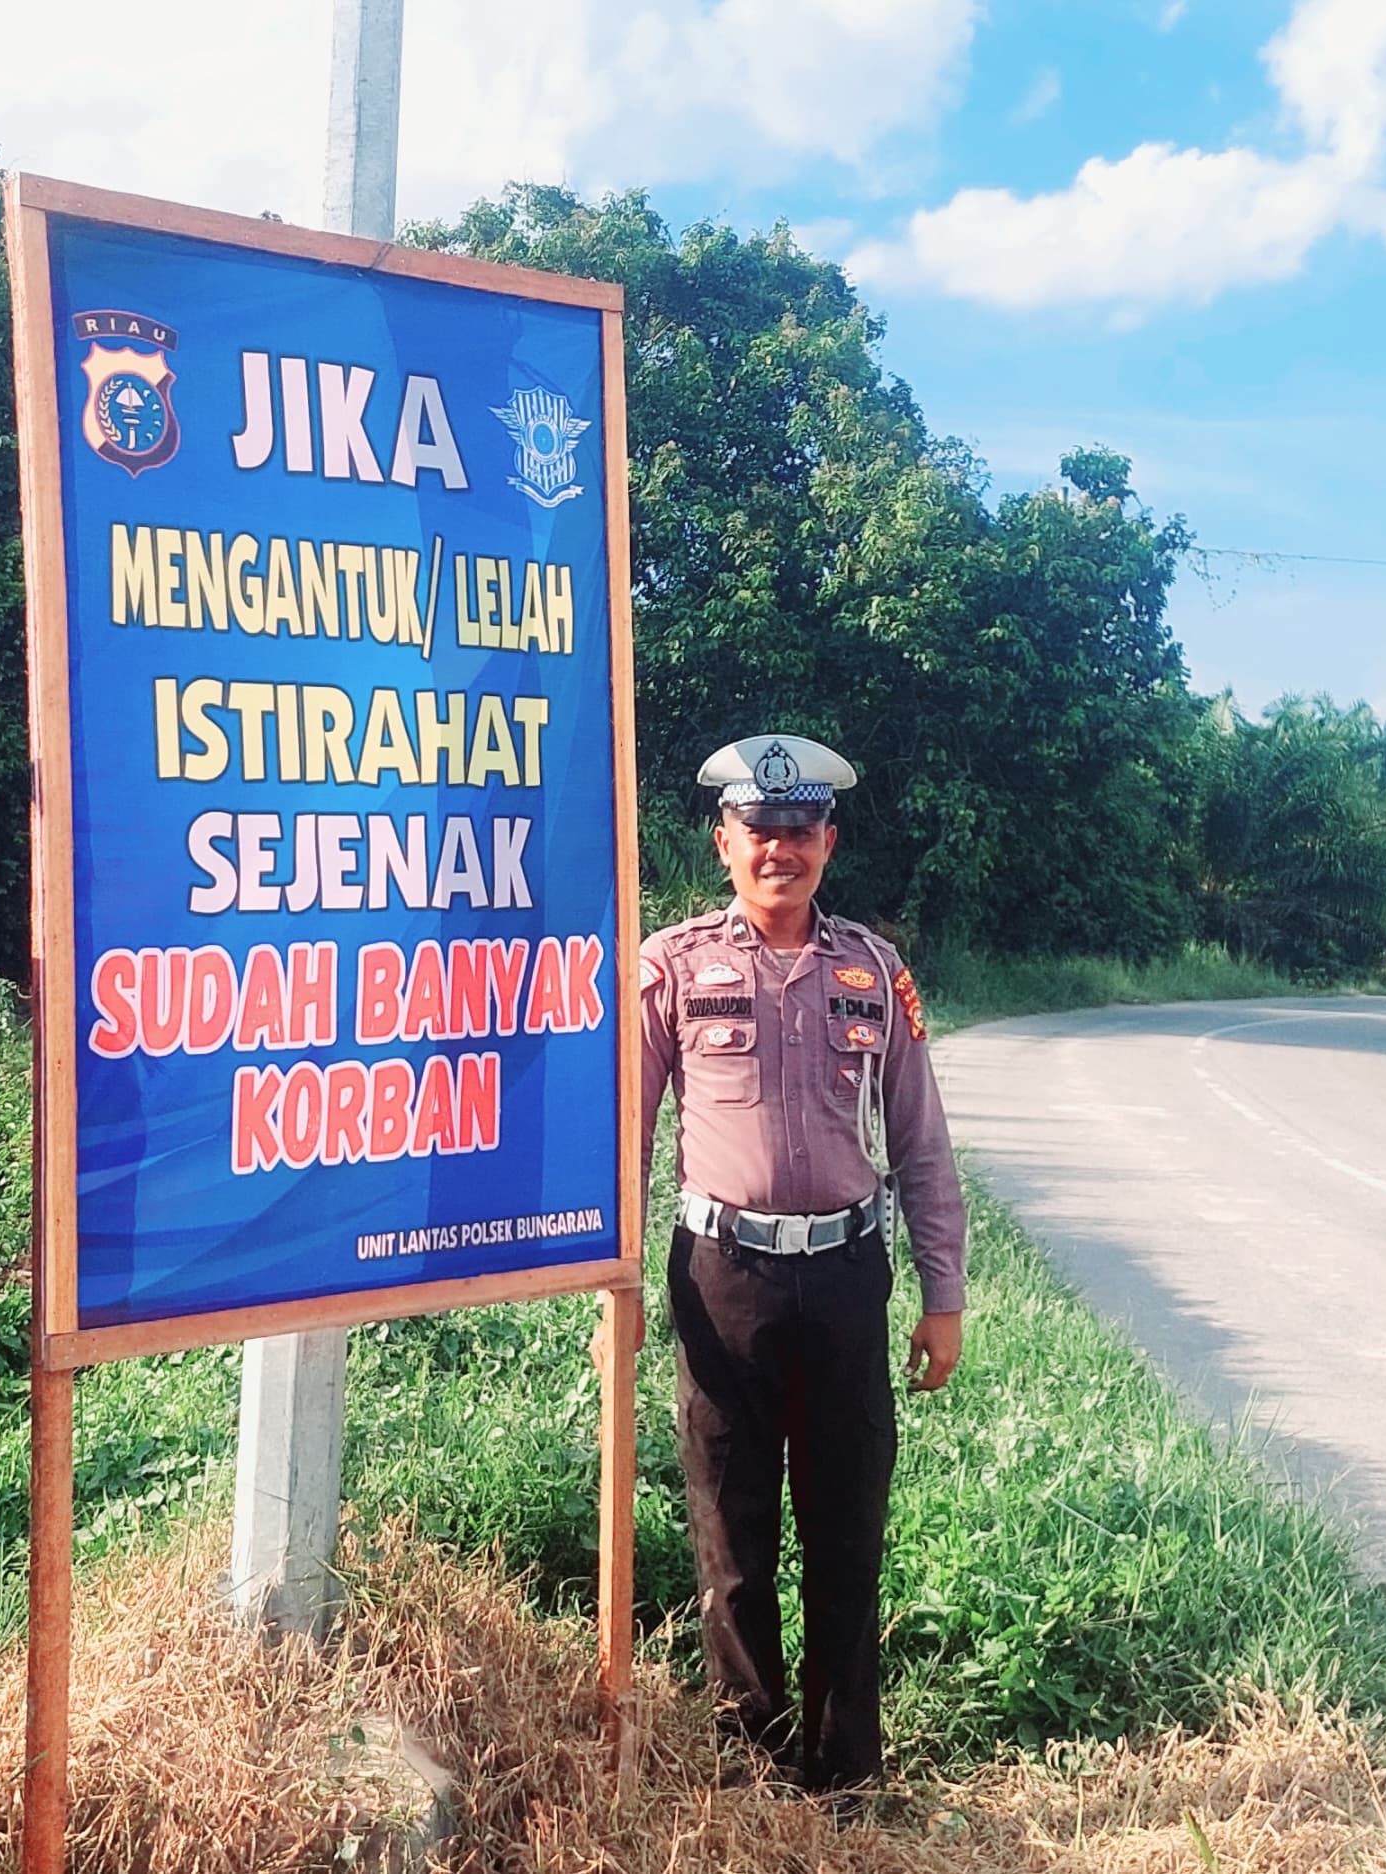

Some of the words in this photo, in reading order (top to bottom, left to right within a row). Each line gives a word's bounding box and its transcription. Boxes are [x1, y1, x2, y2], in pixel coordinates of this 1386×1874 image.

[84, 317, 166, 341] RIAU
[231, 351, 469, 490] JIKA
[111, 523, 442, 660] MENGANTUK/
[455, 554, 574, 655] LELAH
[154, 678, 550, 788] ISTIRAHAT
[187, 811, 534, 914] SEJENAK
[89, 940, 338, 1060] SUDAH
[354, 934, 605, 1046] BANYAK
[231, 1051, 501, 1176] KORBAN
[357, 1232, 396, 1260] UNIT
[398, 1225, 458, 1258] LANTAS
[461, 1218, 514, 1247] POLSEK
[516, 1208, 603, 1240] BUNGARAYA
